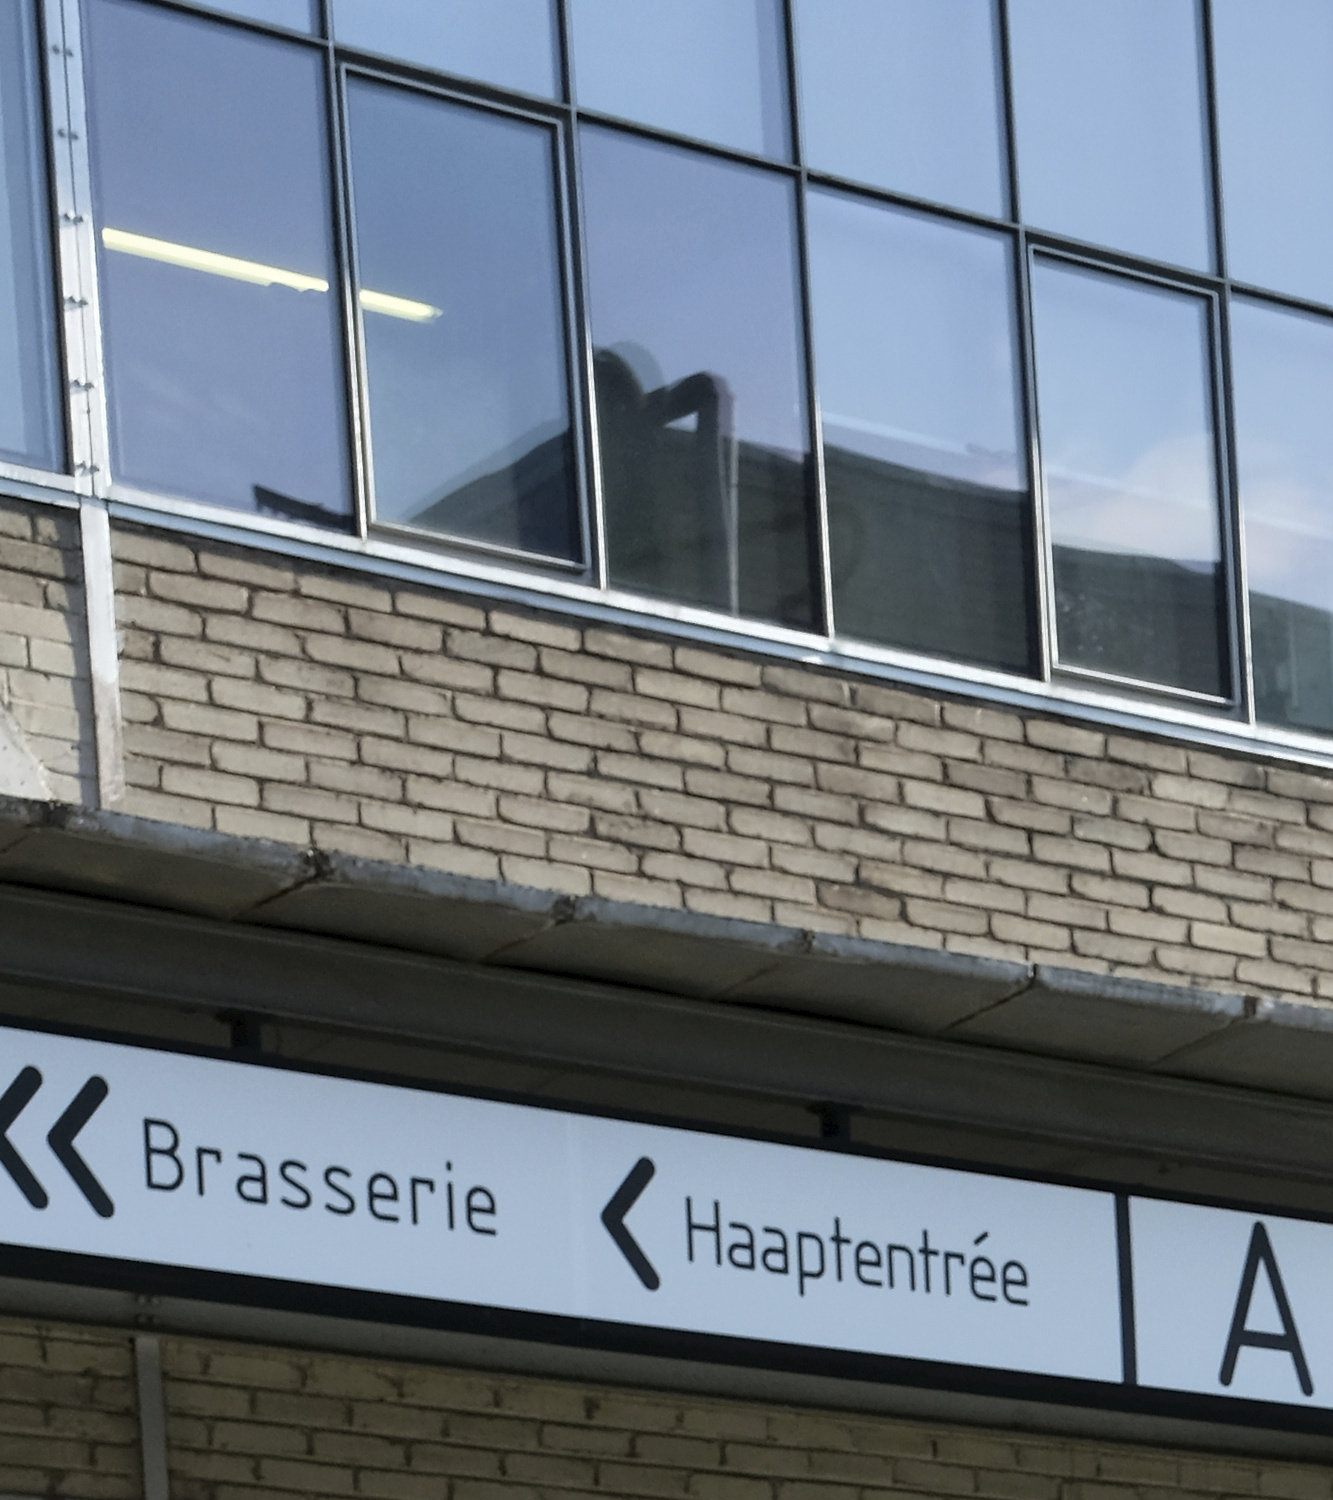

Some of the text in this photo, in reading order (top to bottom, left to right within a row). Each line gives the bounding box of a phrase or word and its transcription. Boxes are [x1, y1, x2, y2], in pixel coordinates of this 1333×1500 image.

[143, 1117, 498, 1237] Brasserie
[684, 1196, 1030, 1308] Haaptentrée
[1218, 1220, 1315, 1397] A
